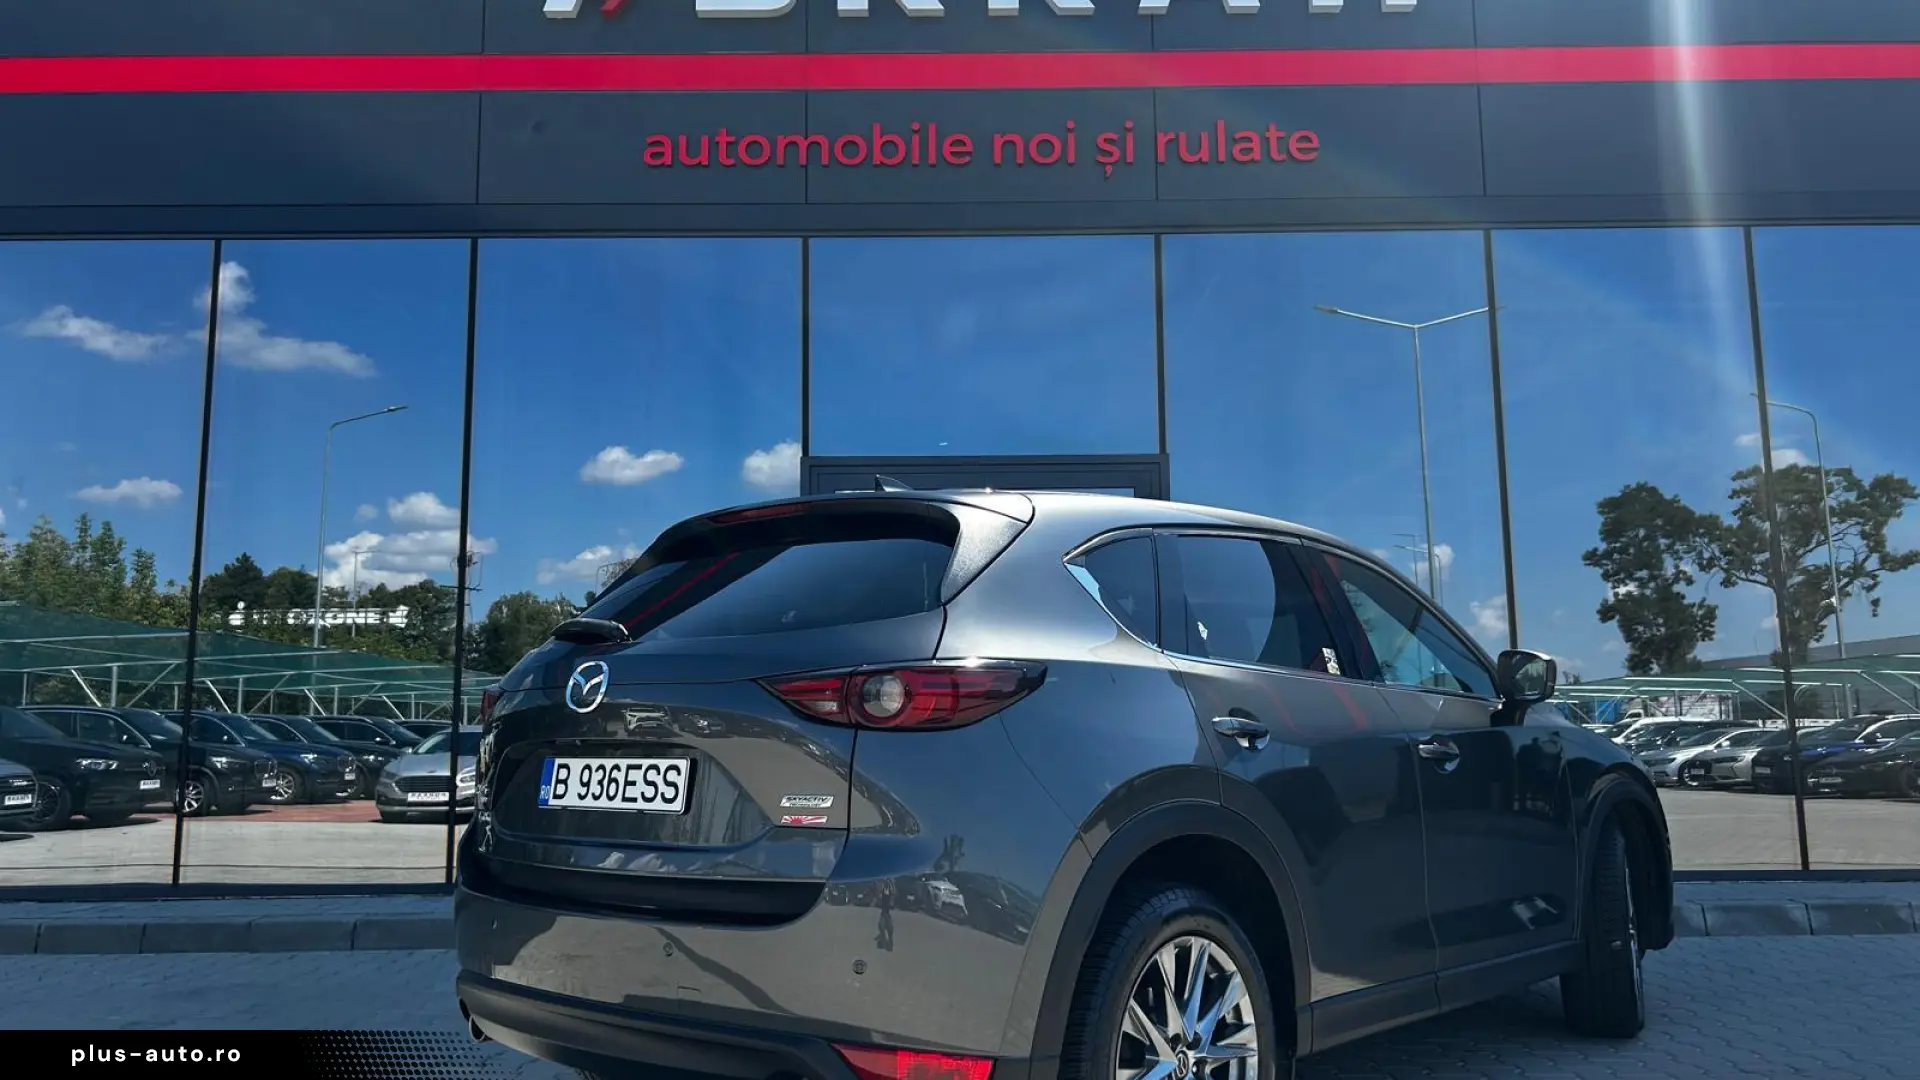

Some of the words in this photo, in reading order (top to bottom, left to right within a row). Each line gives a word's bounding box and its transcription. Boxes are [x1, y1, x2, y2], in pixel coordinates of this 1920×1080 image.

[643, 123, 972, 167] automobile
[993, 121, 1075, 164] noi
[1096, 122, 1134, 178] și
[1156, 121, 1320, 163] rulate
[552, 763, 571, 800] B
[577, 763, 682, 804] 936ESS
